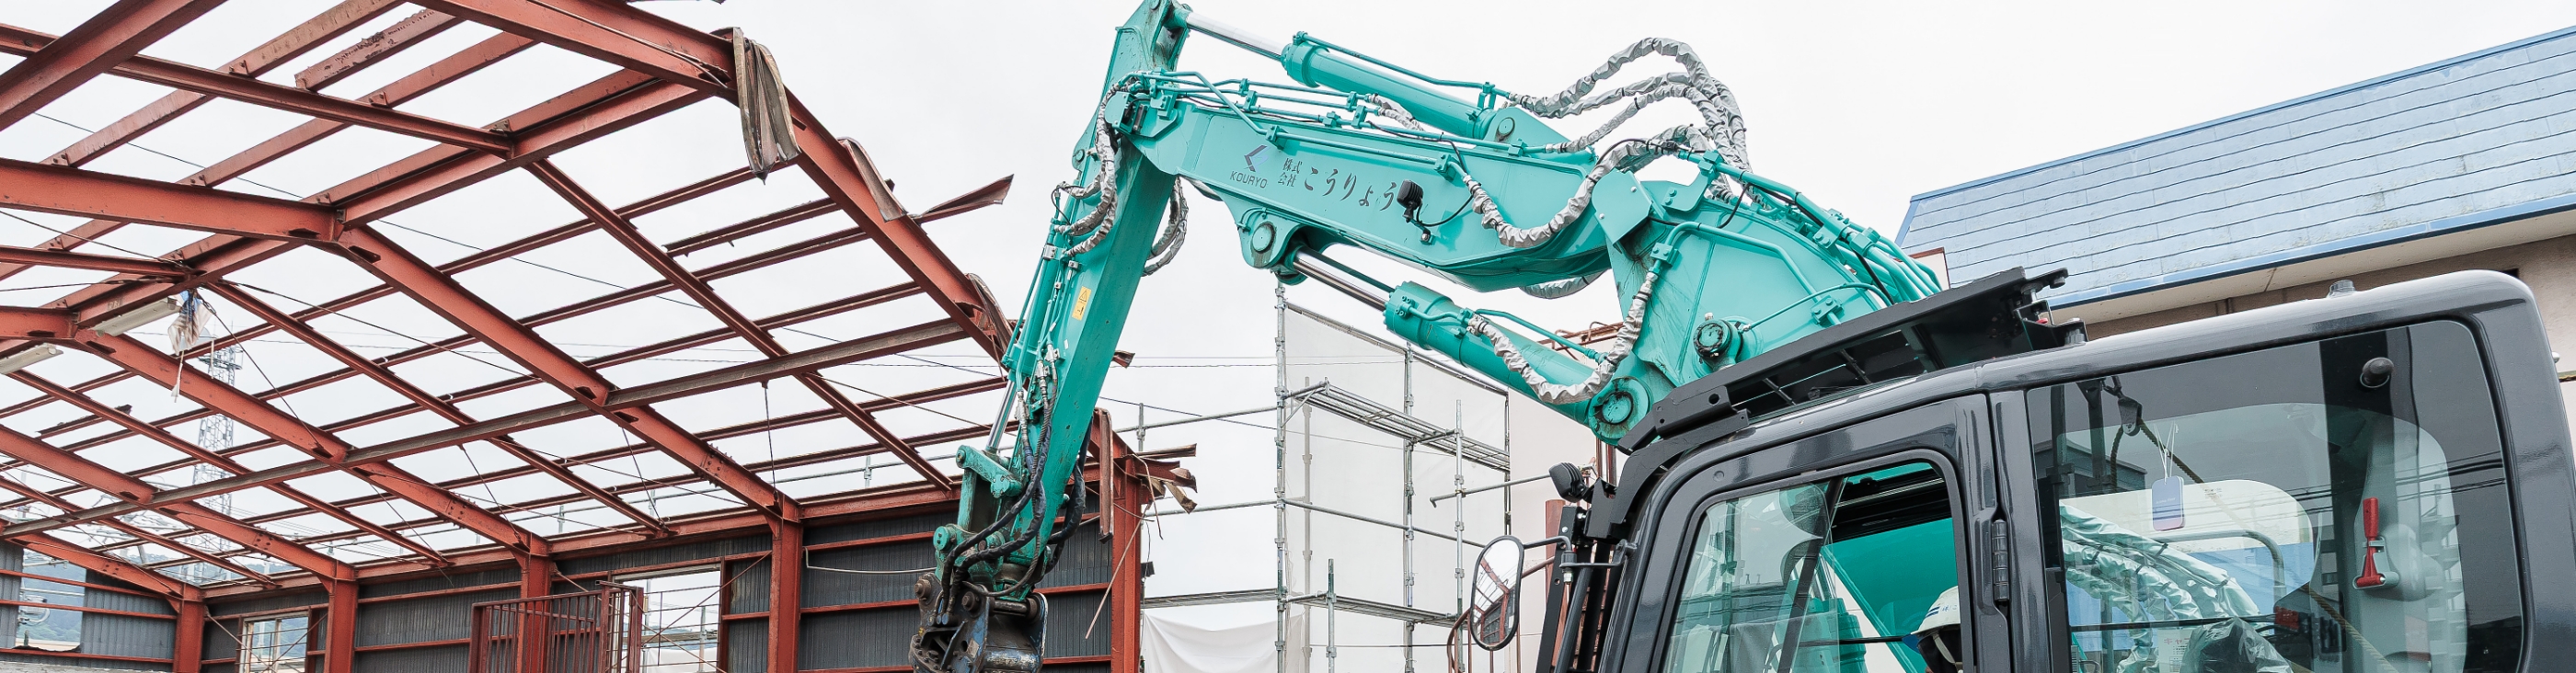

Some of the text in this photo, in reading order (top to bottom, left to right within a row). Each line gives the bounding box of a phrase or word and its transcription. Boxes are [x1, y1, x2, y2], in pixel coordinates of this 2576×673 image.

[1282, 157, 1303, 174] 株式
[1229, 170, 1268, 188] KOURYO
[1277, 172, 1297, 187] 会社
[1304, 166, 1397, 211] こうりょう
